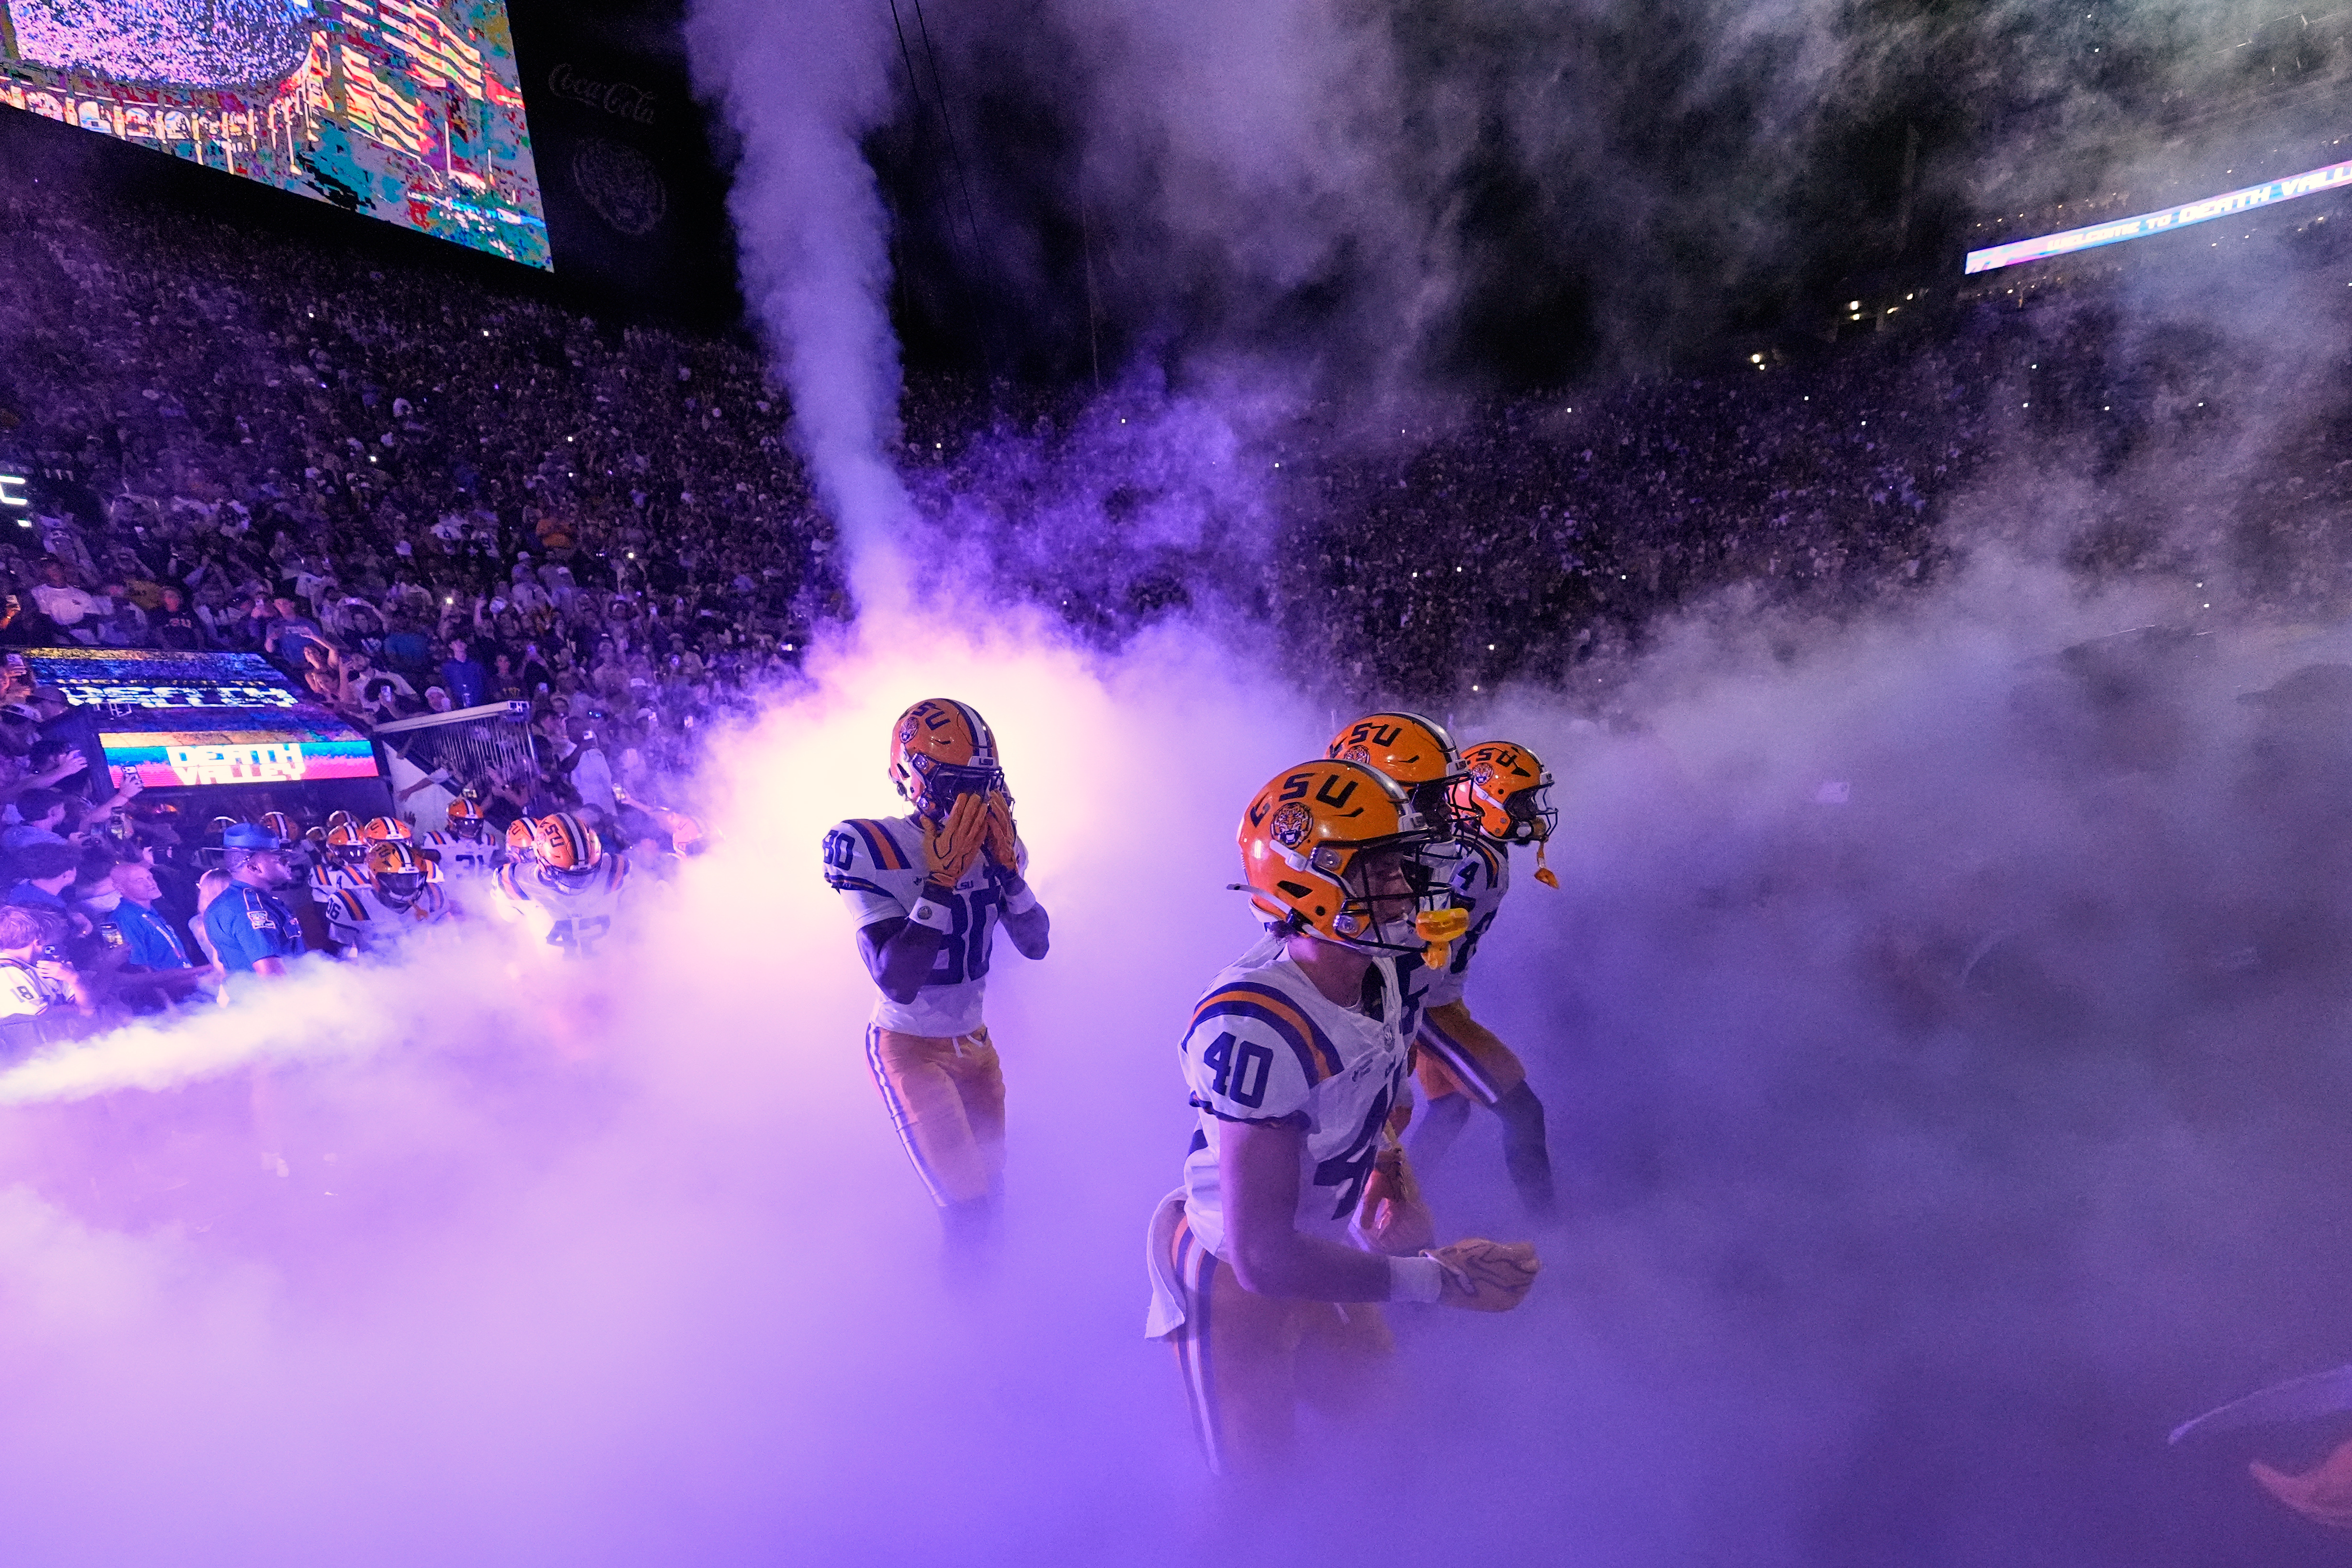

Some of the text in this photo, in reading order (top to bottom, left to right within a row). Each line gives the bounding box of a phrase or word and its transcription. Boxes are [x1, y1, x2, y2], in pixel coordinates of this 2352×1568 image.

[2047, 166, 2352, 251] WELCOME TO DEATH VALL
[165, 743, 304, 767] DEATH
[172, 762, 306, 786] VALLEY
[1249, 773, 1359, 828] LSU
[822, 829, 855, 871] 80
[1203, 1031, 1274, 1109] 40
